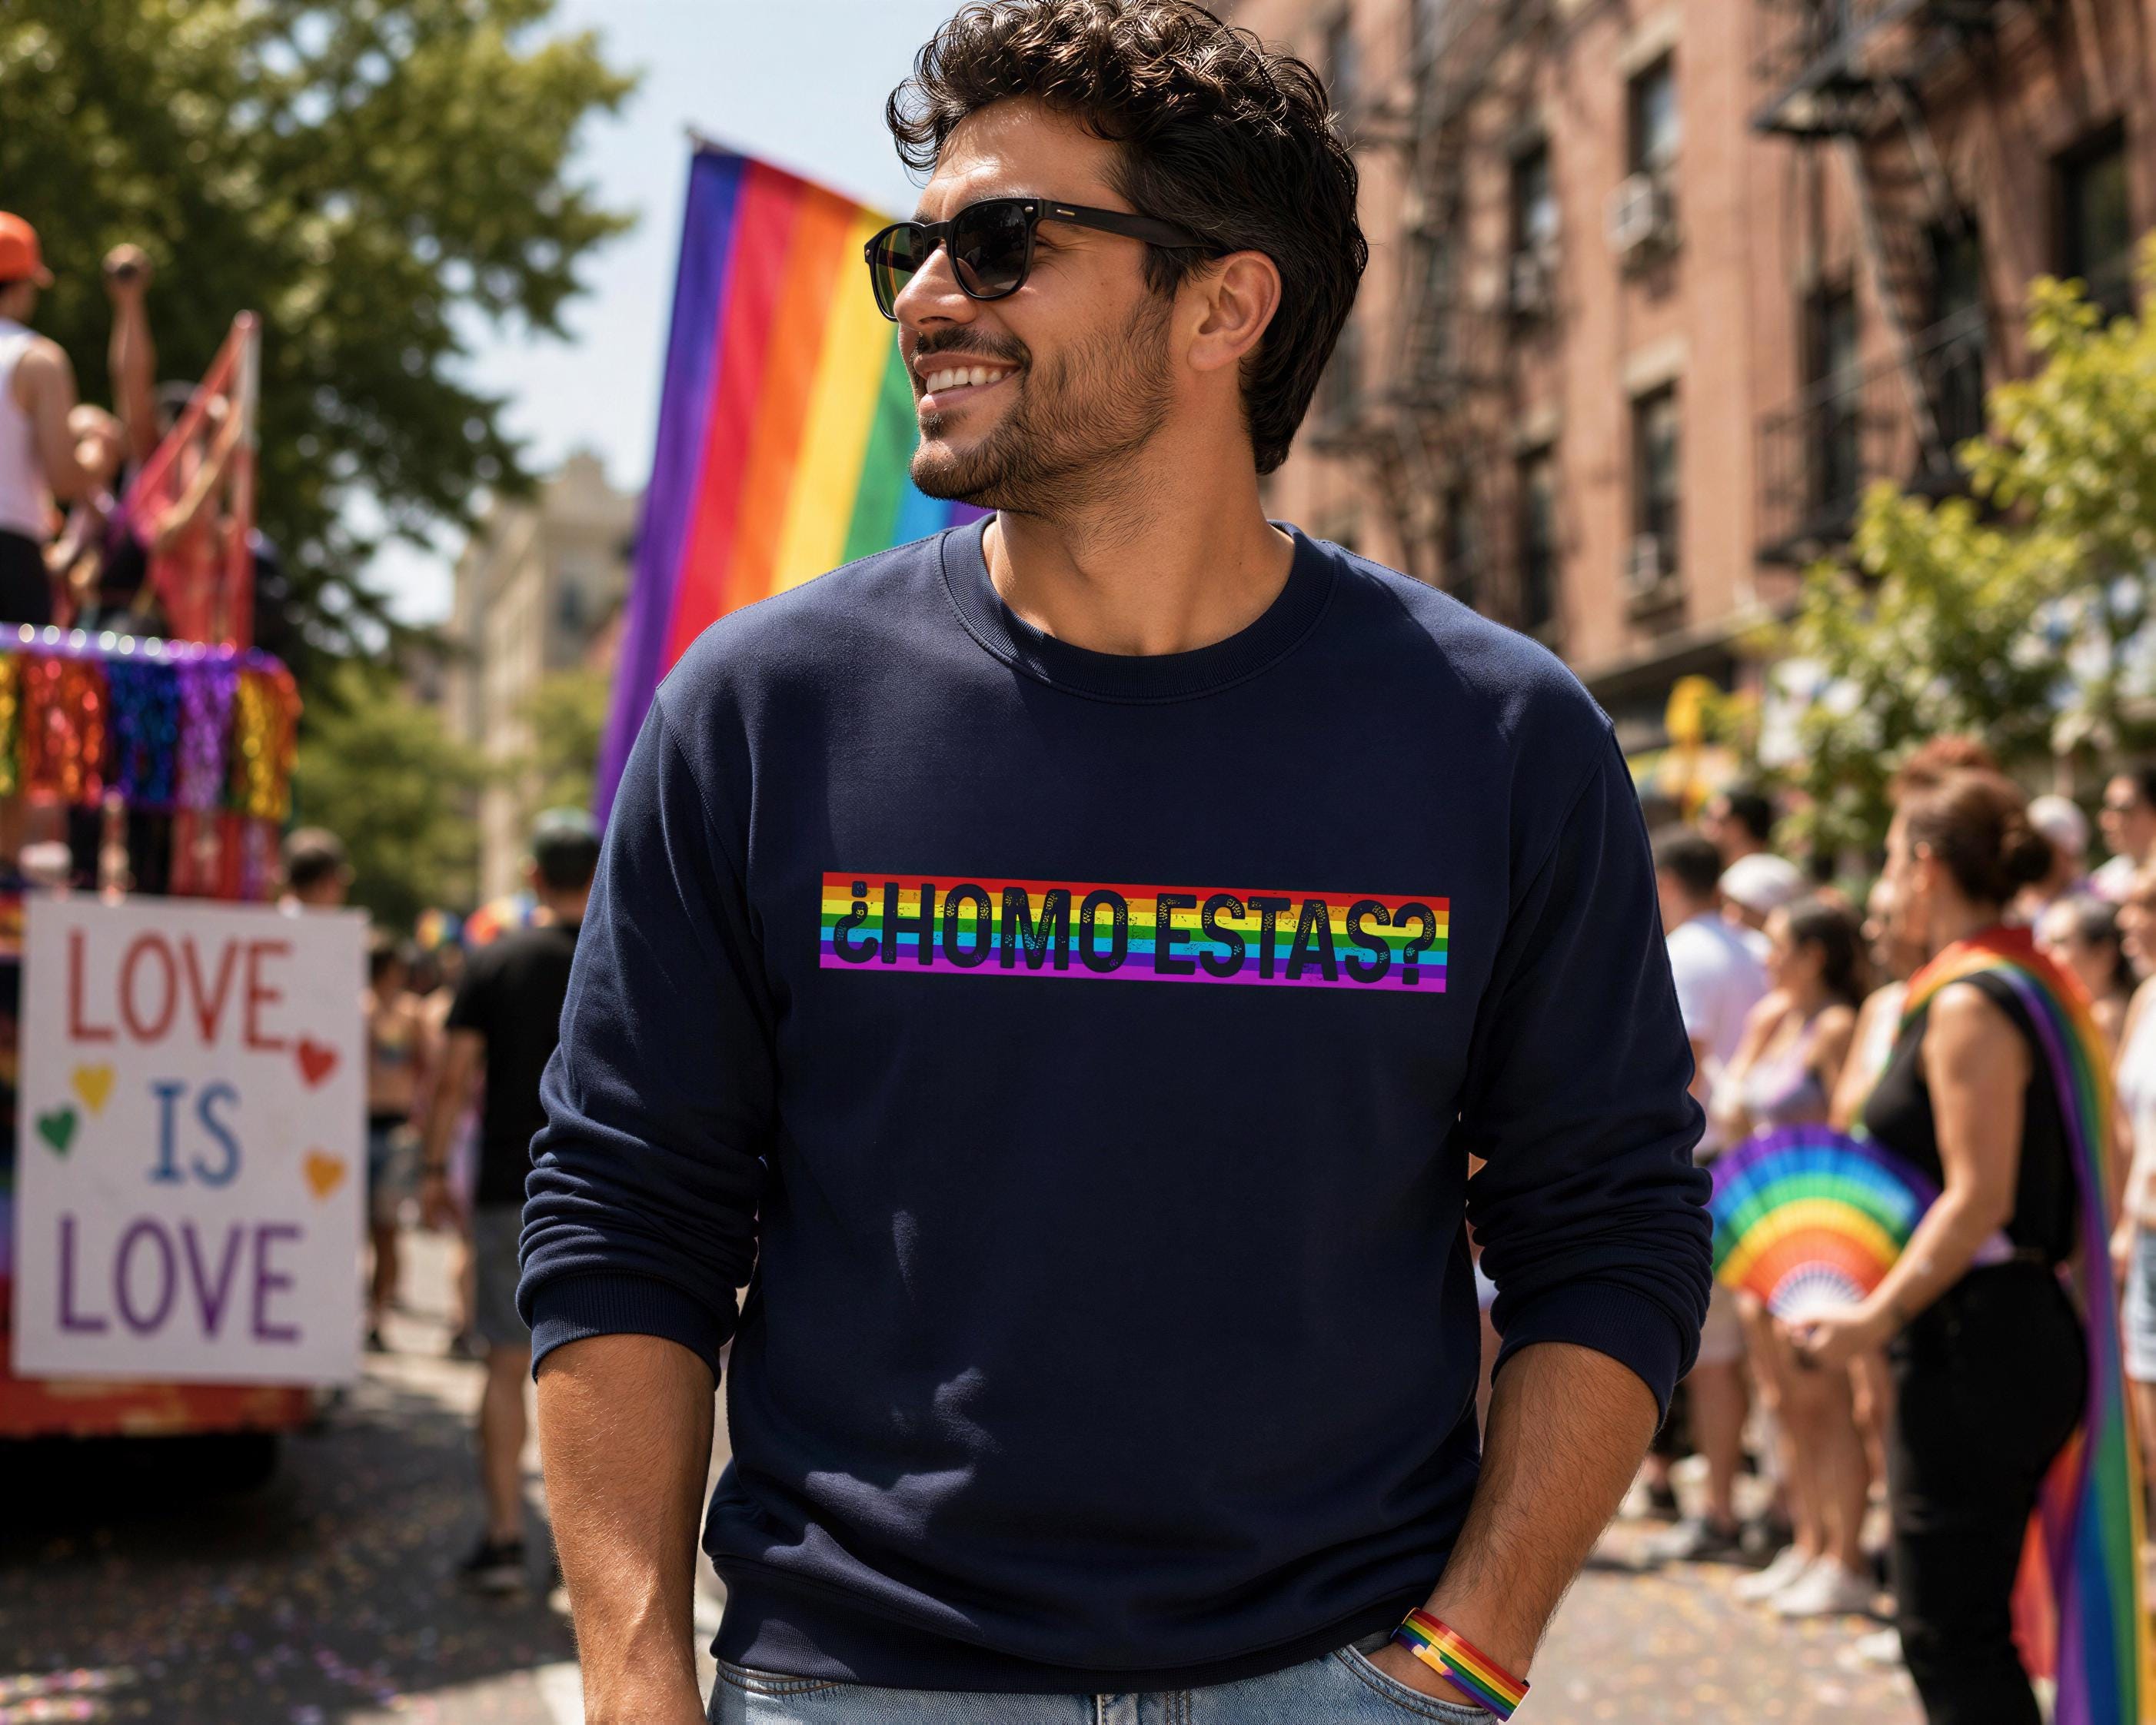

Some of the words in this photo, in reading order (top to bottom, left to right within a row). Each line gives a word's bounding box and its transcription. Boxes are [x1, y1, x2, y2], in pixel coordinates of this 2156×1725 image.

[67, 929, 291, 1052] LOVE
[833, 880, 1128, 973] ¿HOMO
[1153, 892, 1436, 985] ESTAS?
[148, 1079, 243, 1188] IS
[58, 1214, 303, 1344] LOVE
